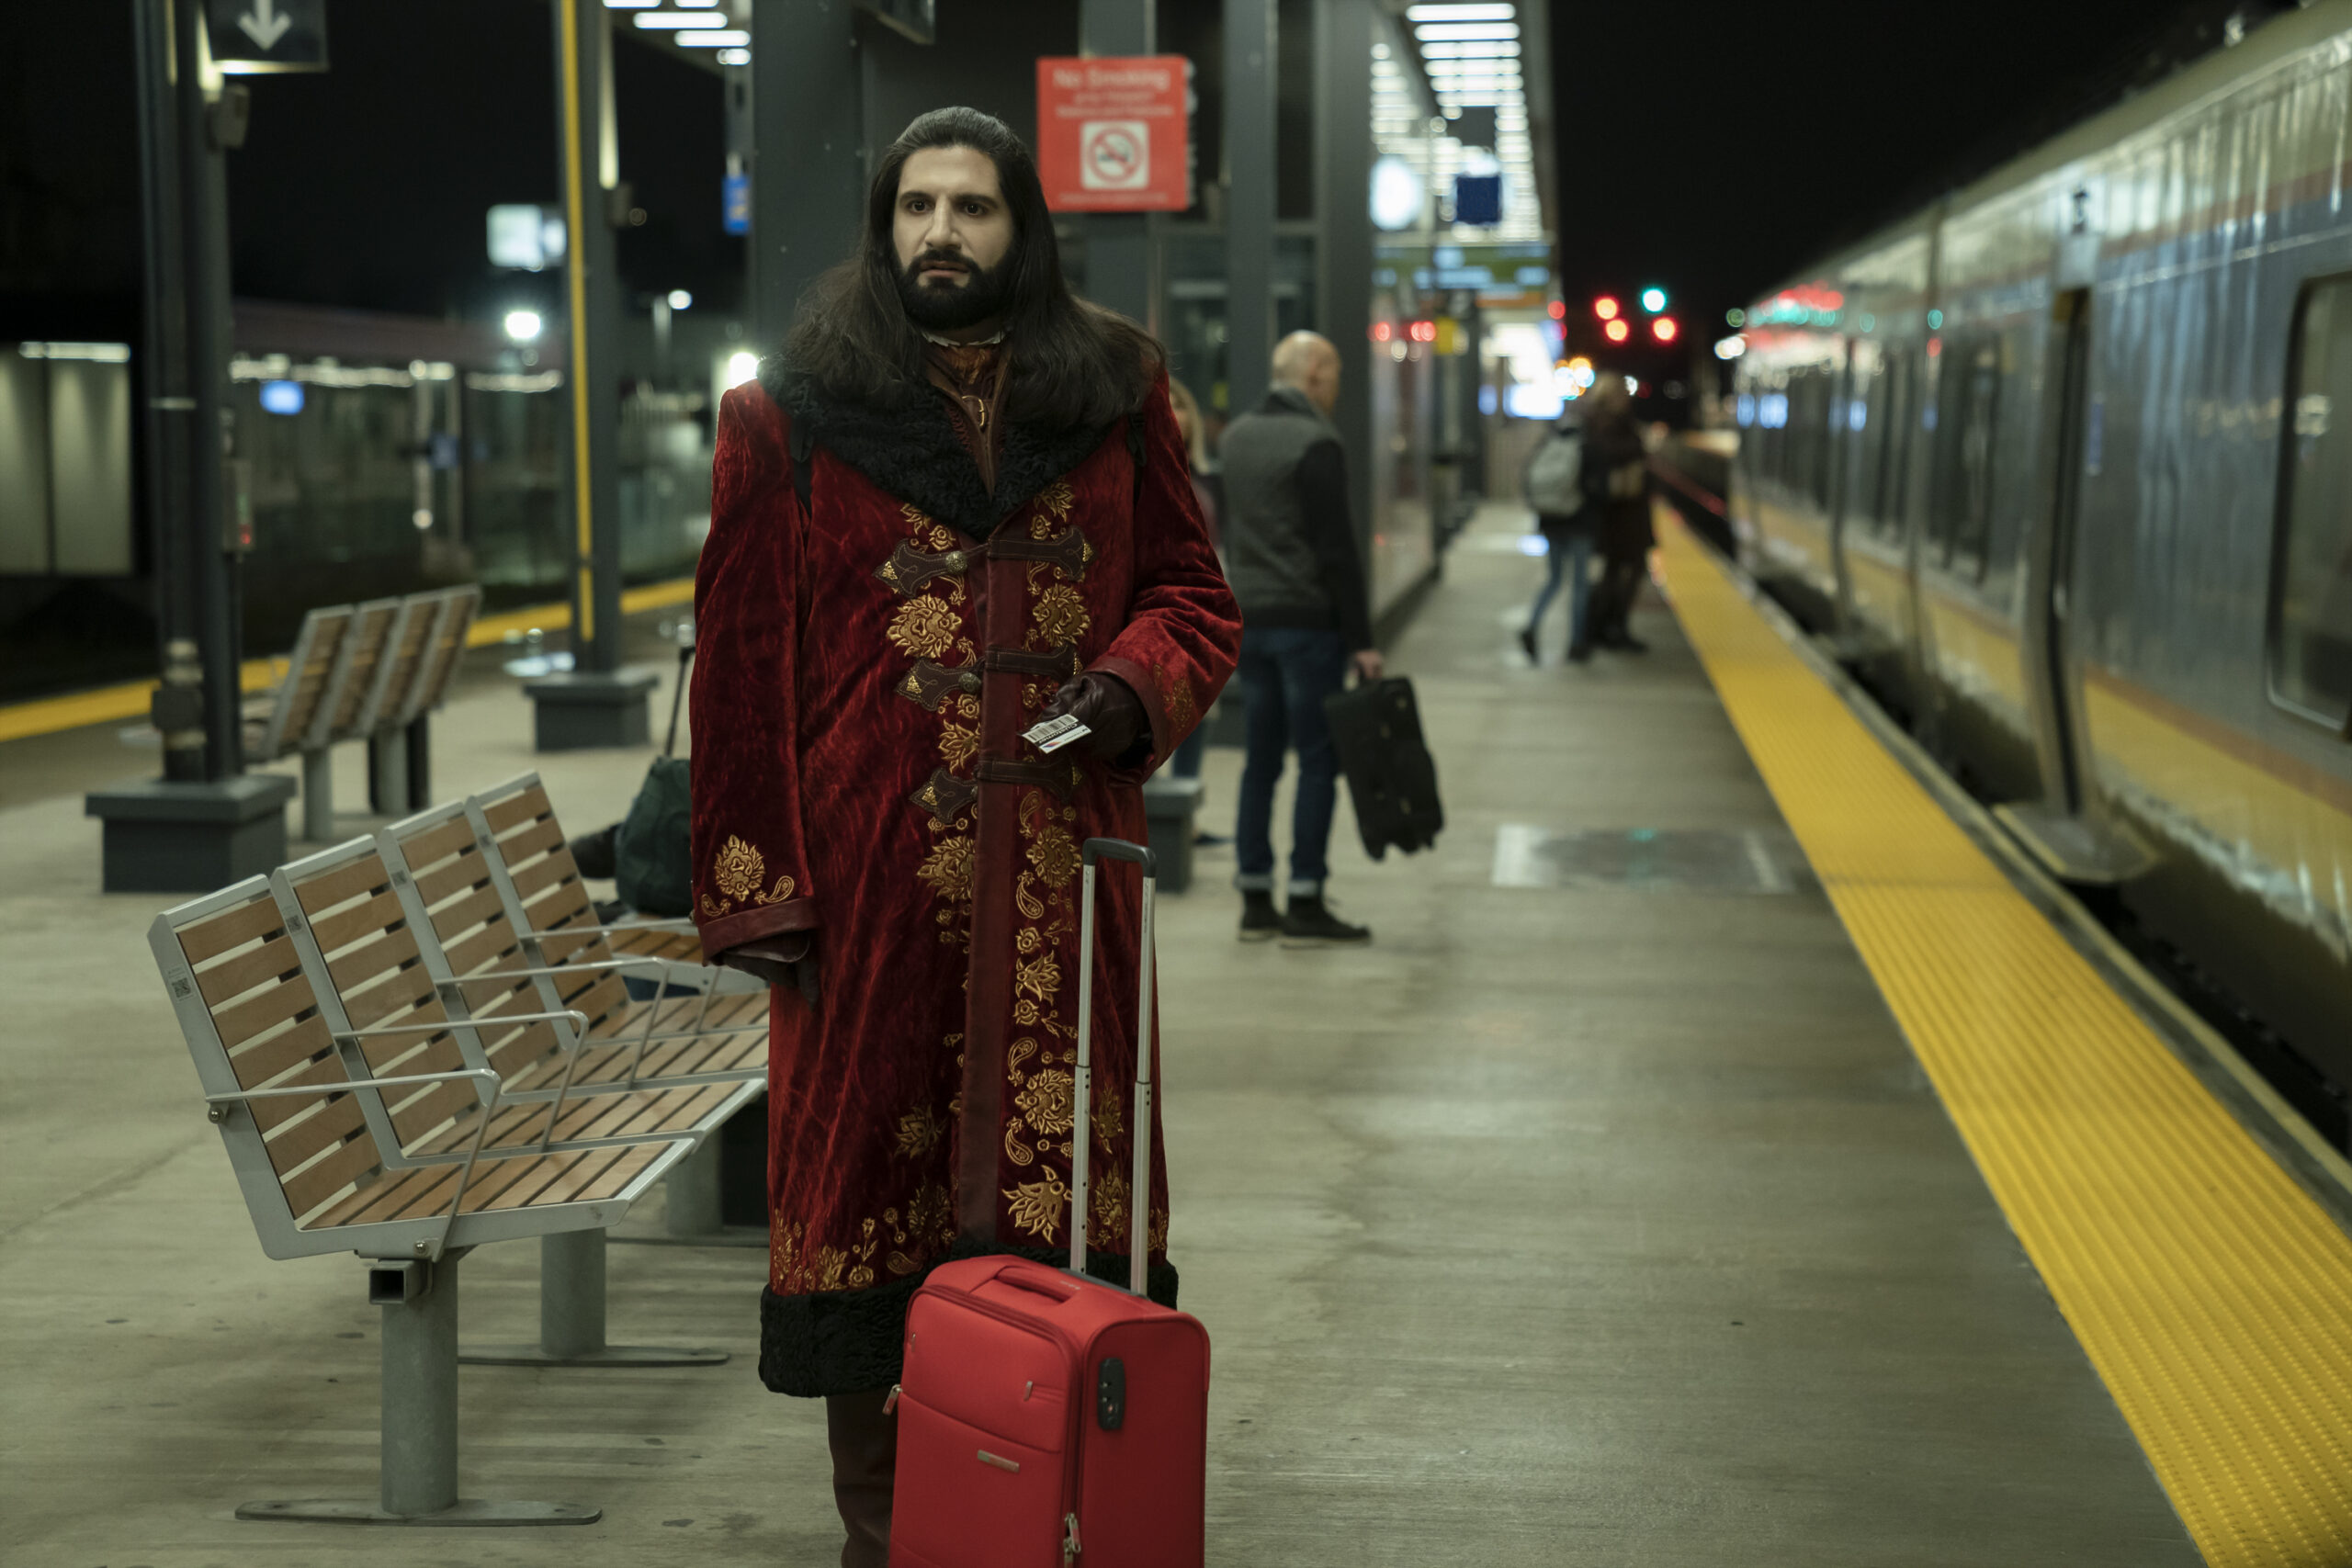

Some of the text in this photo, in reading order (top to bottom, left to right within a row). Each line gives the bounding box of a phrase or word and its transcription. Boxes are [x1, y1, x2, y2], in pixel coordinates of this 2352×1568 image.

[1053, 67, 1170, 93] No Smoking
[1038, 723, 1078, 743] Customer
